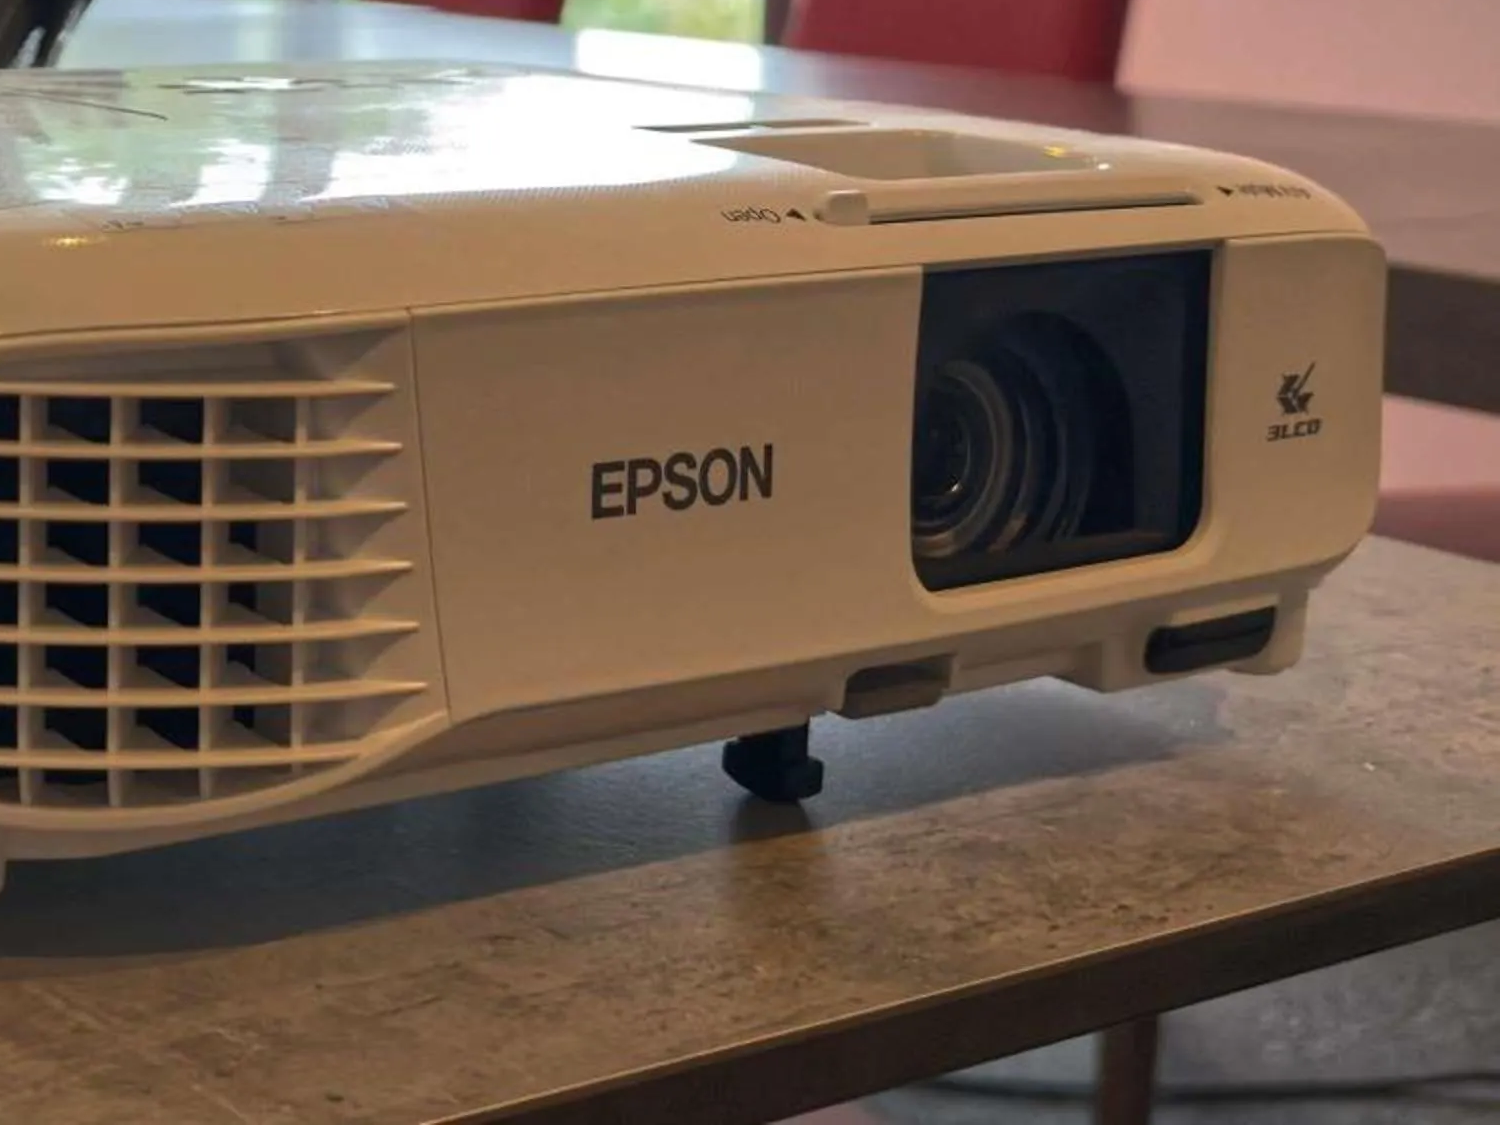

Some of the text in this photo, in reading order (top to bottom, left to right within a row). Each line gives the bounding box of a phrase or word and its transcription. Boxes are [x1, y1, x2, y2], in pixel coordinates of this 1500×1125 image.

[720, 207, 782, 224] Open
[1266, 418, 1323, 442] 3LCD
[591, 443, 774, 519] EPSON
